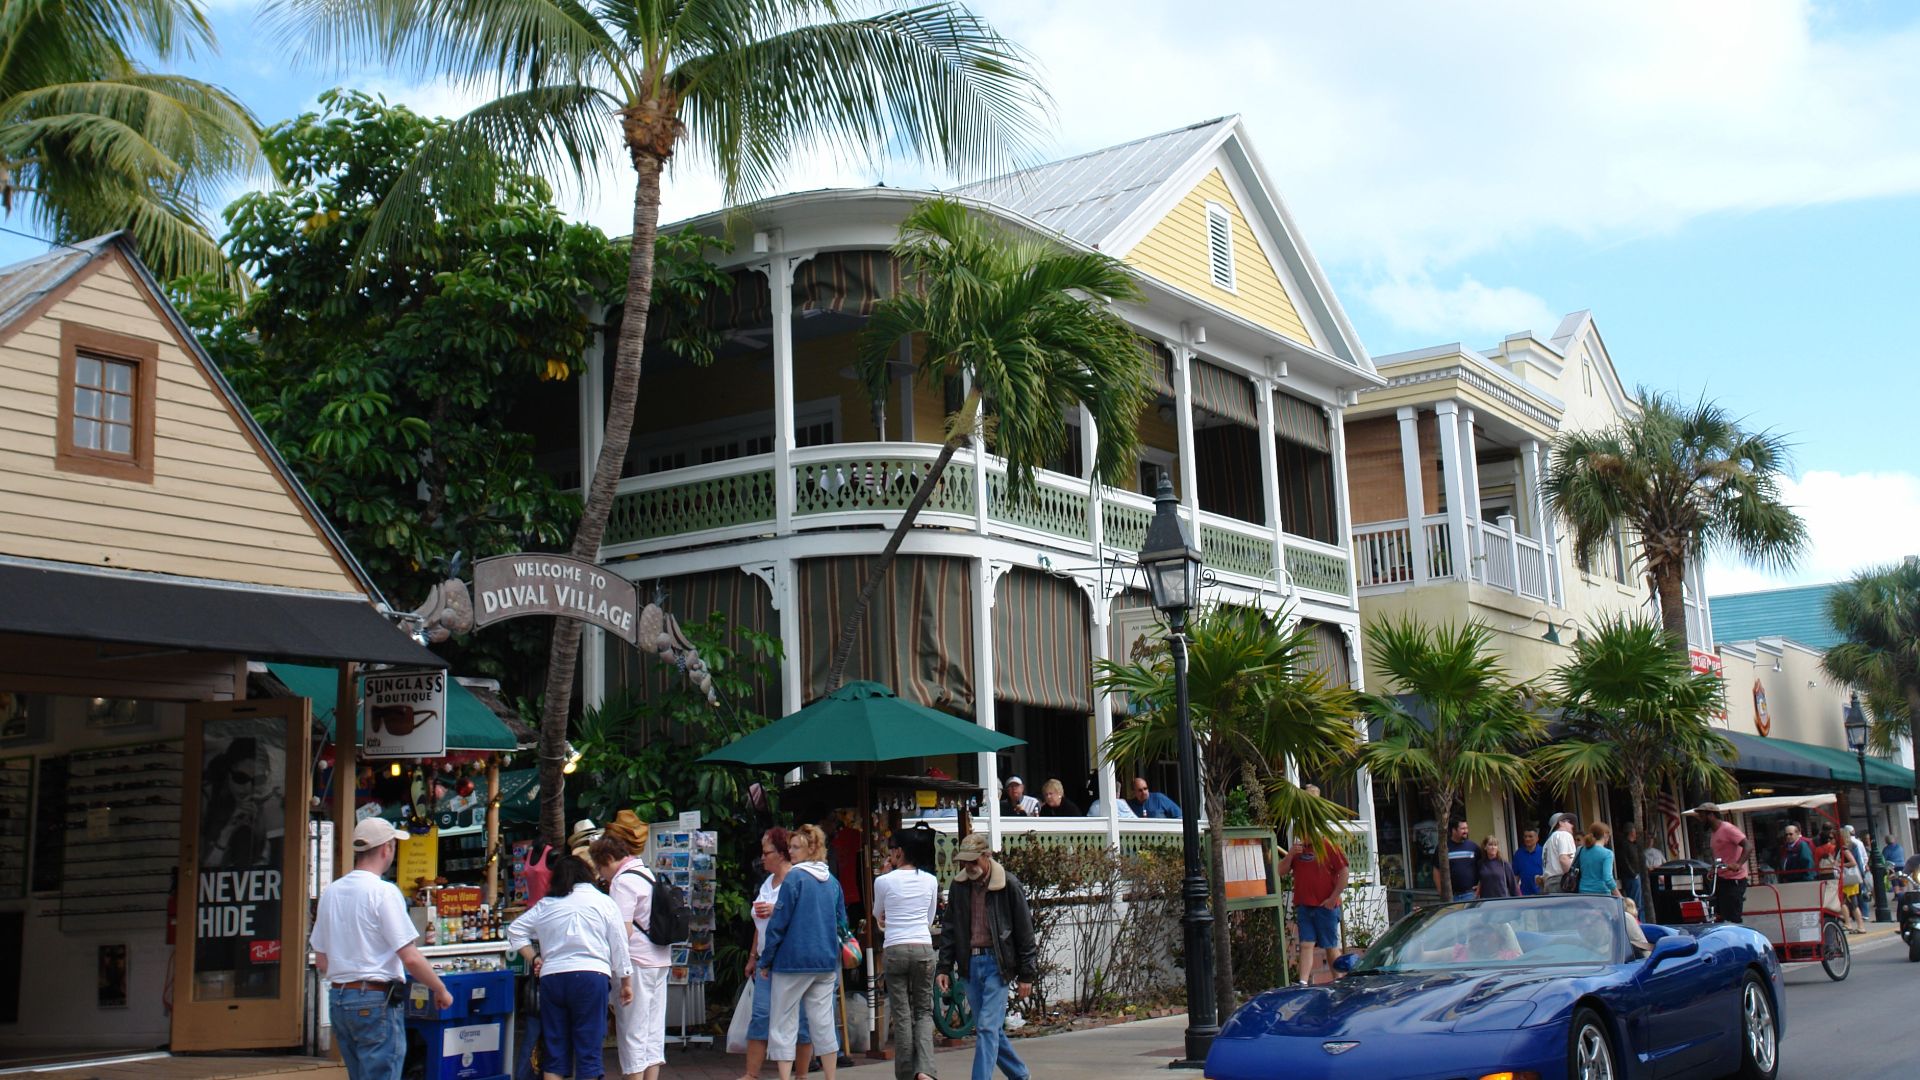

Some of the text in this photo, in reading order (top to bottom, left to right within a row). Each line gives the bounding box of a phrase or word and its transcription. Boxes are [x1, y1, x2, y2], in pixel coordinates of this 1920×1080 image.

[513, 562, 606, 590] WELCOME TO
[482, 584, 633, 631] DUVAL VILLAGE
[366, 676, 442, 697] SUNGLASS
[376, 692, 432, 703] BOUTIQUE
[199, 869, 282, 903] NEVER
[198, 905, 256, 938] HIDE
